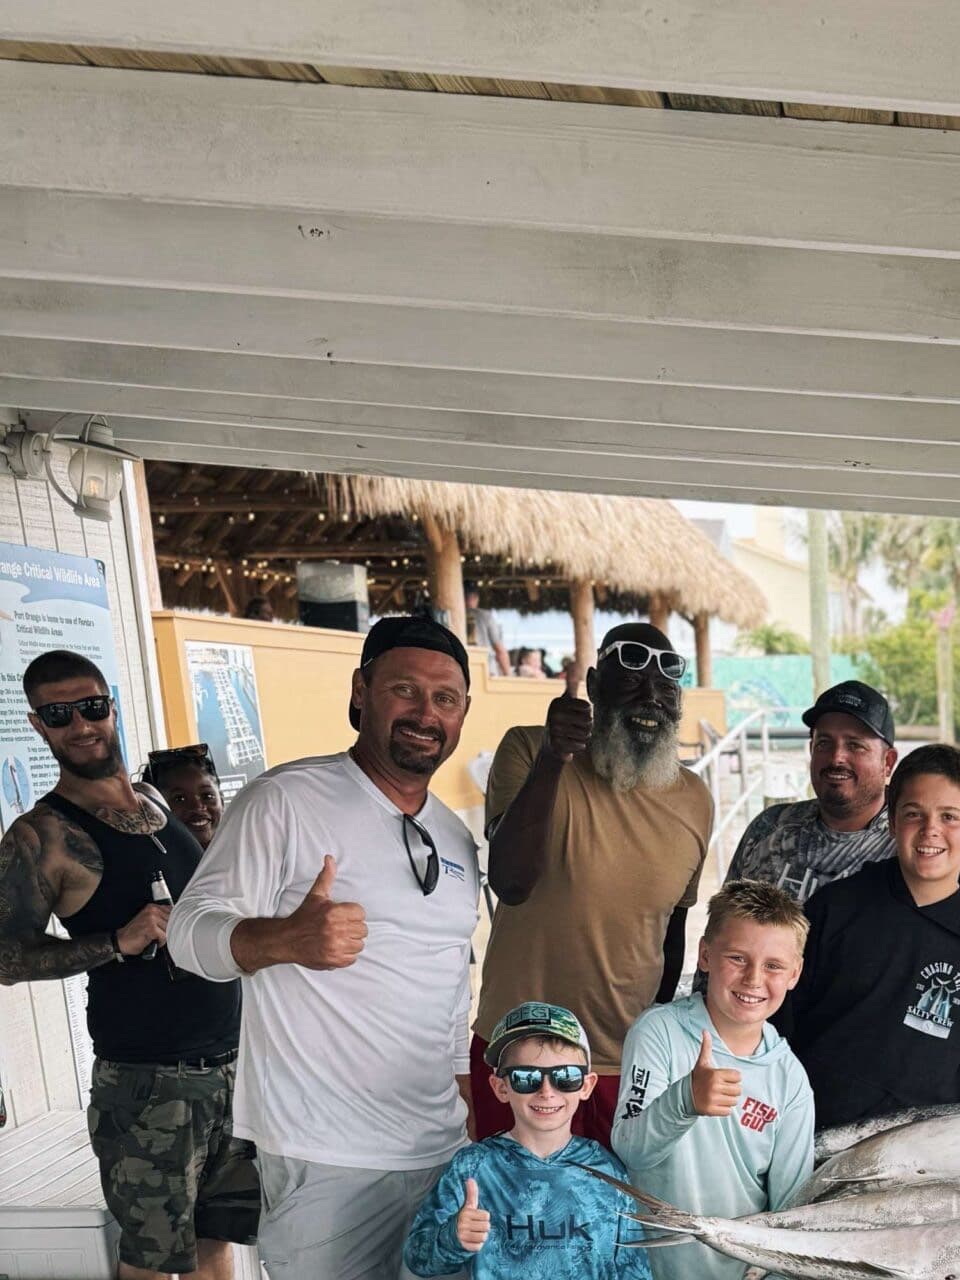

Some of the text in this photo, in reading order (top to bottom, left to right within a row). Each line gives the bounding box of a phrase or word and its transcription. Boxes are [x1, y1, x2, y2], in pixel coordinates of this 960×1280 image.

[0, 561, 101, 588] ange Critical Wildlife Area
[920, 961, 954, 980] CHASING
[907, 1005, 955, 1028] SALTY CREW
[742, 1096, 778, 1121] FISH
[506, 1214, 594, 1241] Huk
